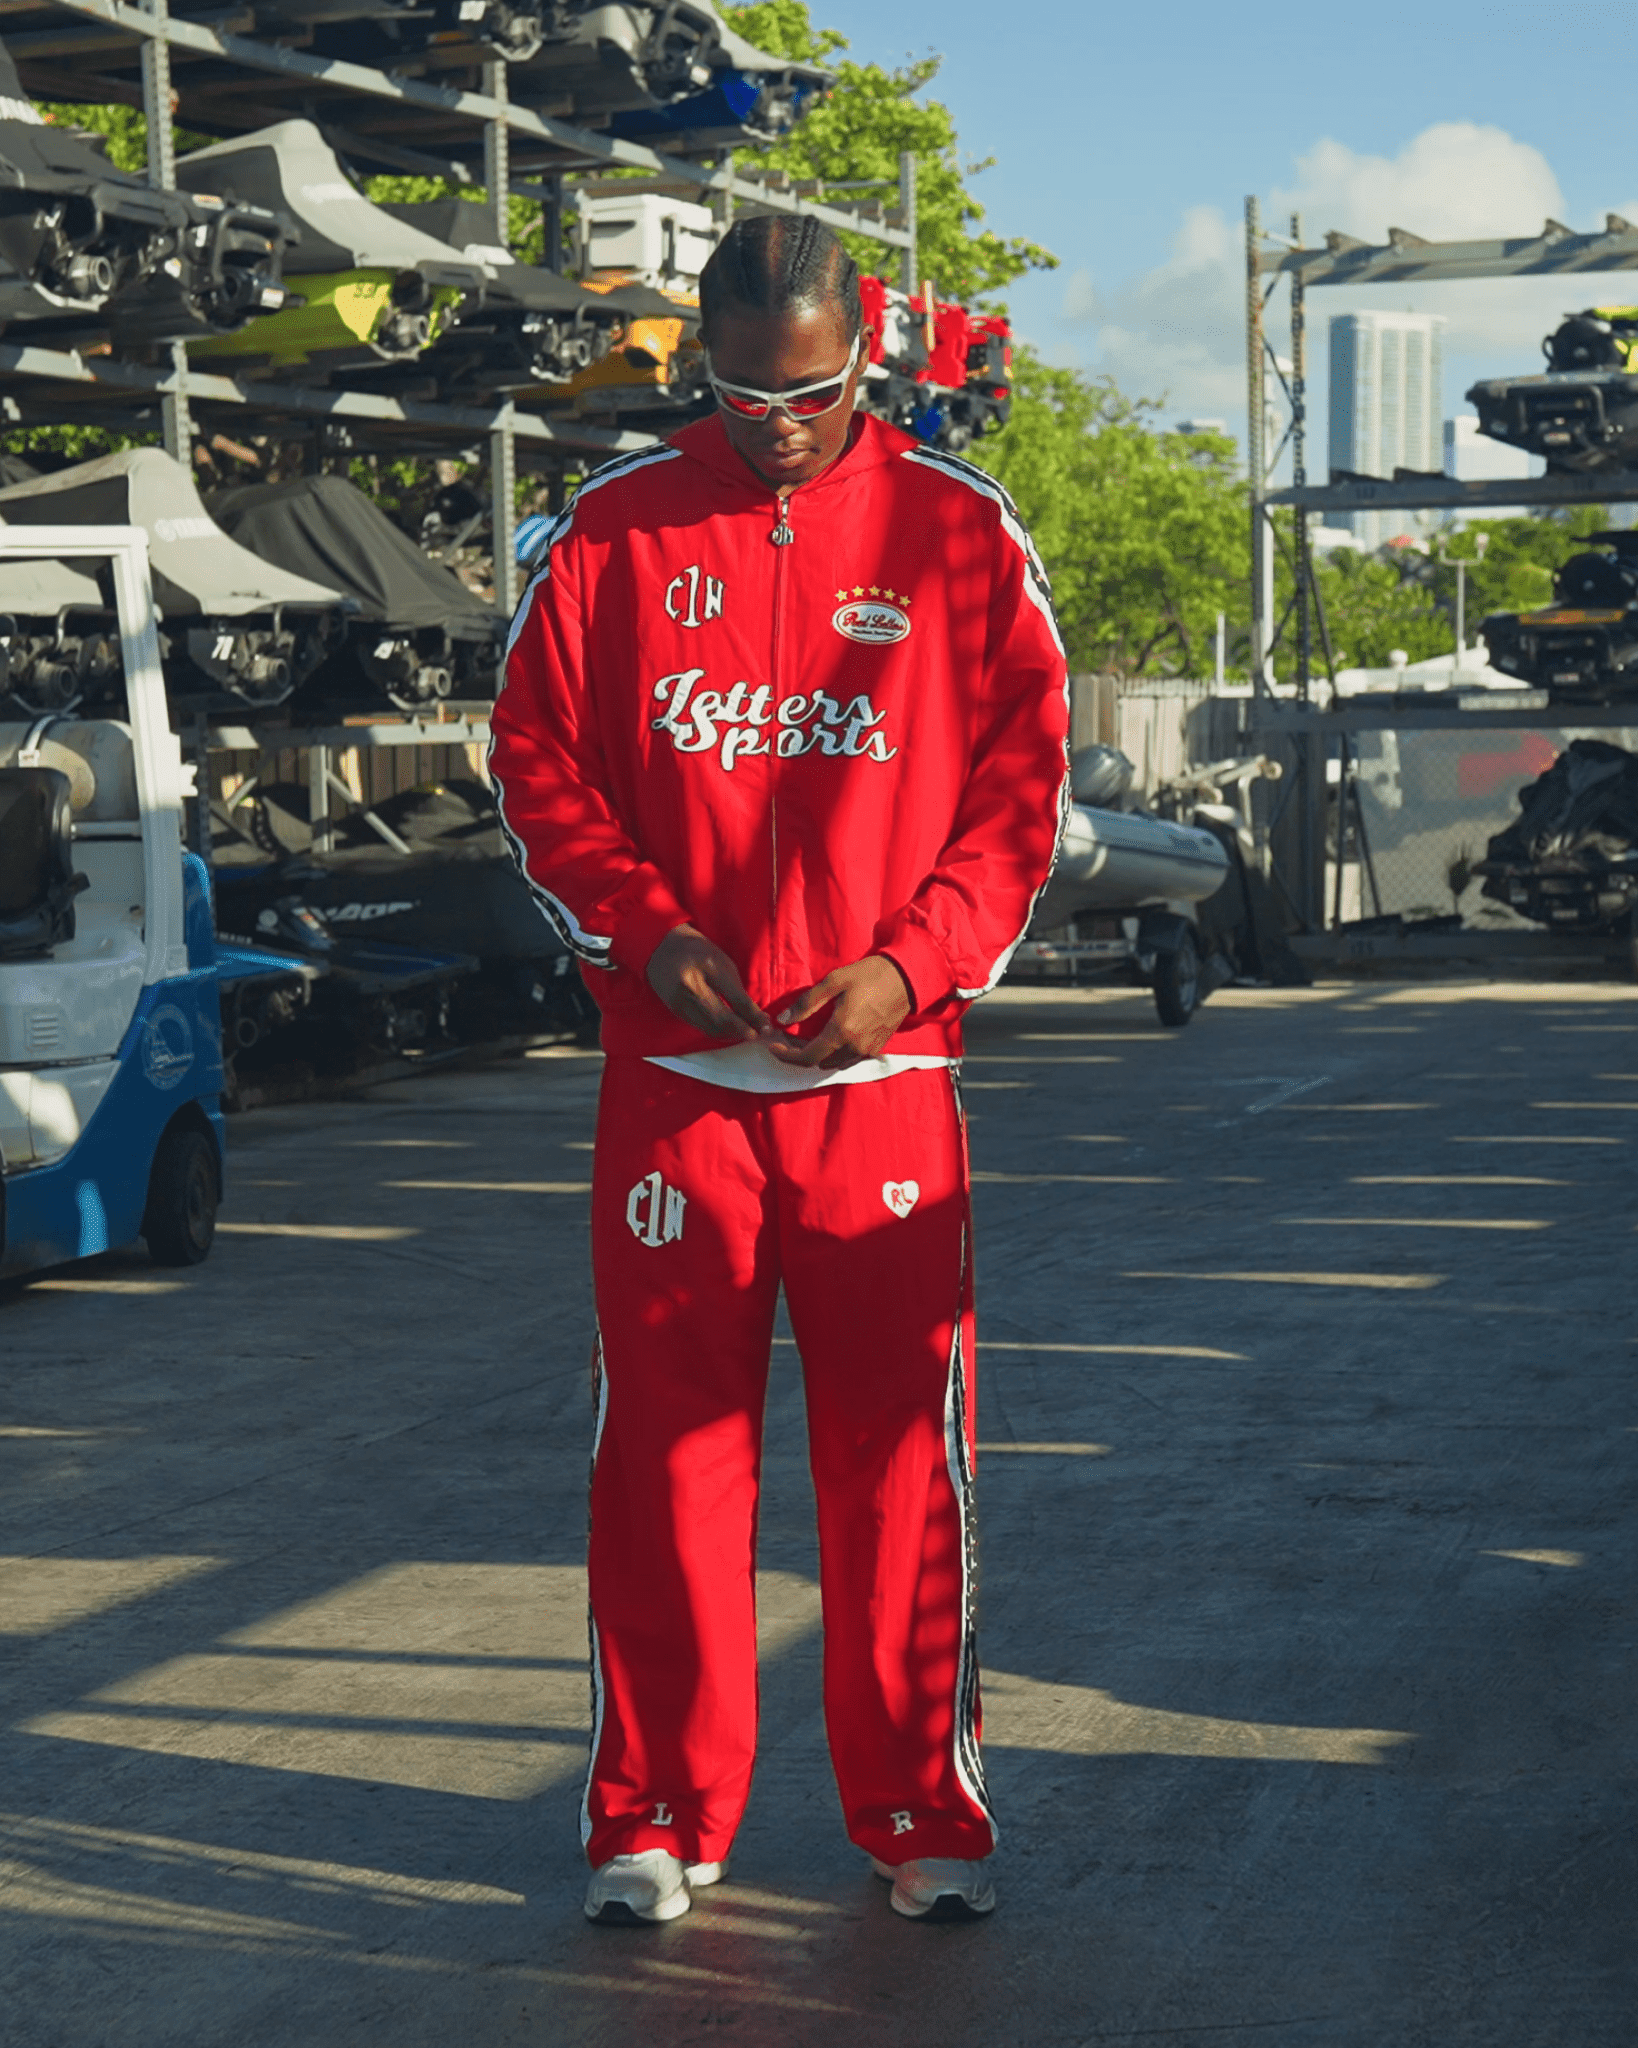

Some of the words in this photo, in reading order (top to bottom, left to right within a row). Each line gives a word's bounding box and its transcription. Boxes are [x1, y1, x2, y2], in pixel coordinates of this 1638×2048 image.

[651, 668, 886, 735] Letters
[673, 700, 898, 771] Sports
[891, 1188, 914, 1208] RL
[651, 1802, 673, 1826] L
[890, 1810, 915, 1836] R
